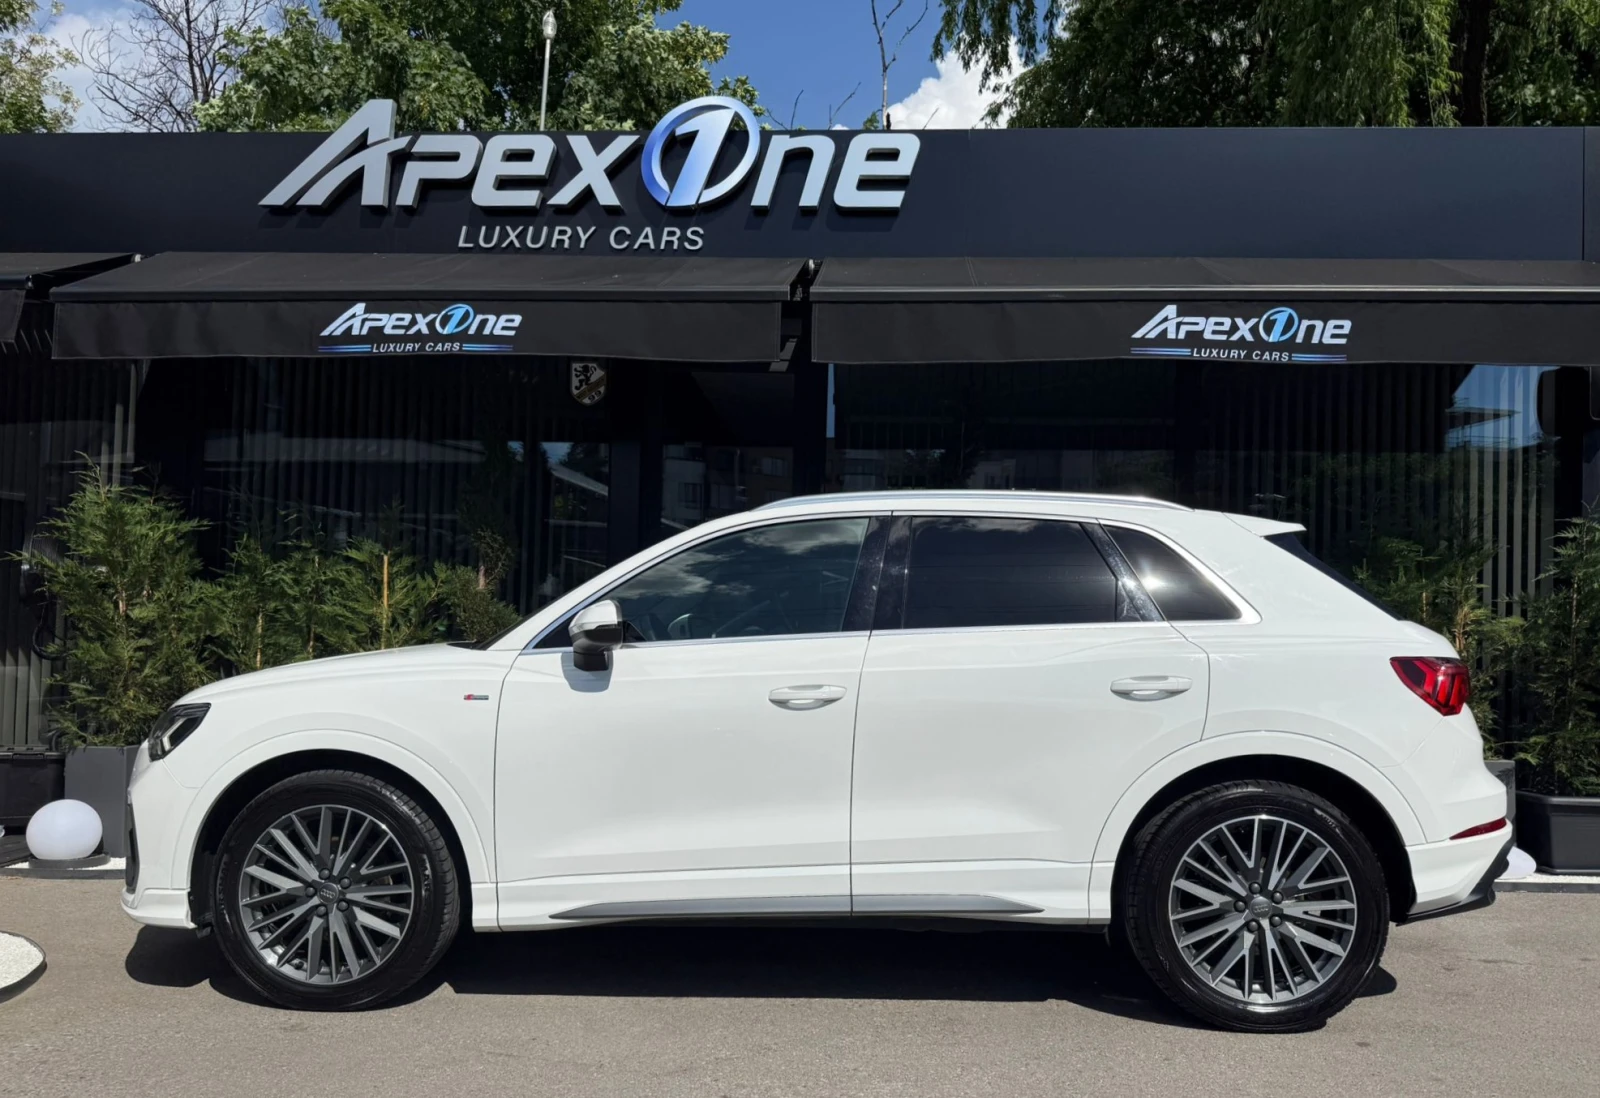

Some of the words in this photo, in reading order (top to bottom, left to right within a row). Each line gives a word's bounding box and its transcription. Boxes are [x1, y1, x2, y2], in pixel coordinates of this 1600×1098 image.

[457, 225, 597, 249] LUXURY
[608, 225, 705, 251] CARS
[372, 342, 421, 353] LUXURY
[425, 341, 461, 352] CARS
[1192, 347, 1248, 360] LUXURY
[1252, 350, 1290, 362] CARS
